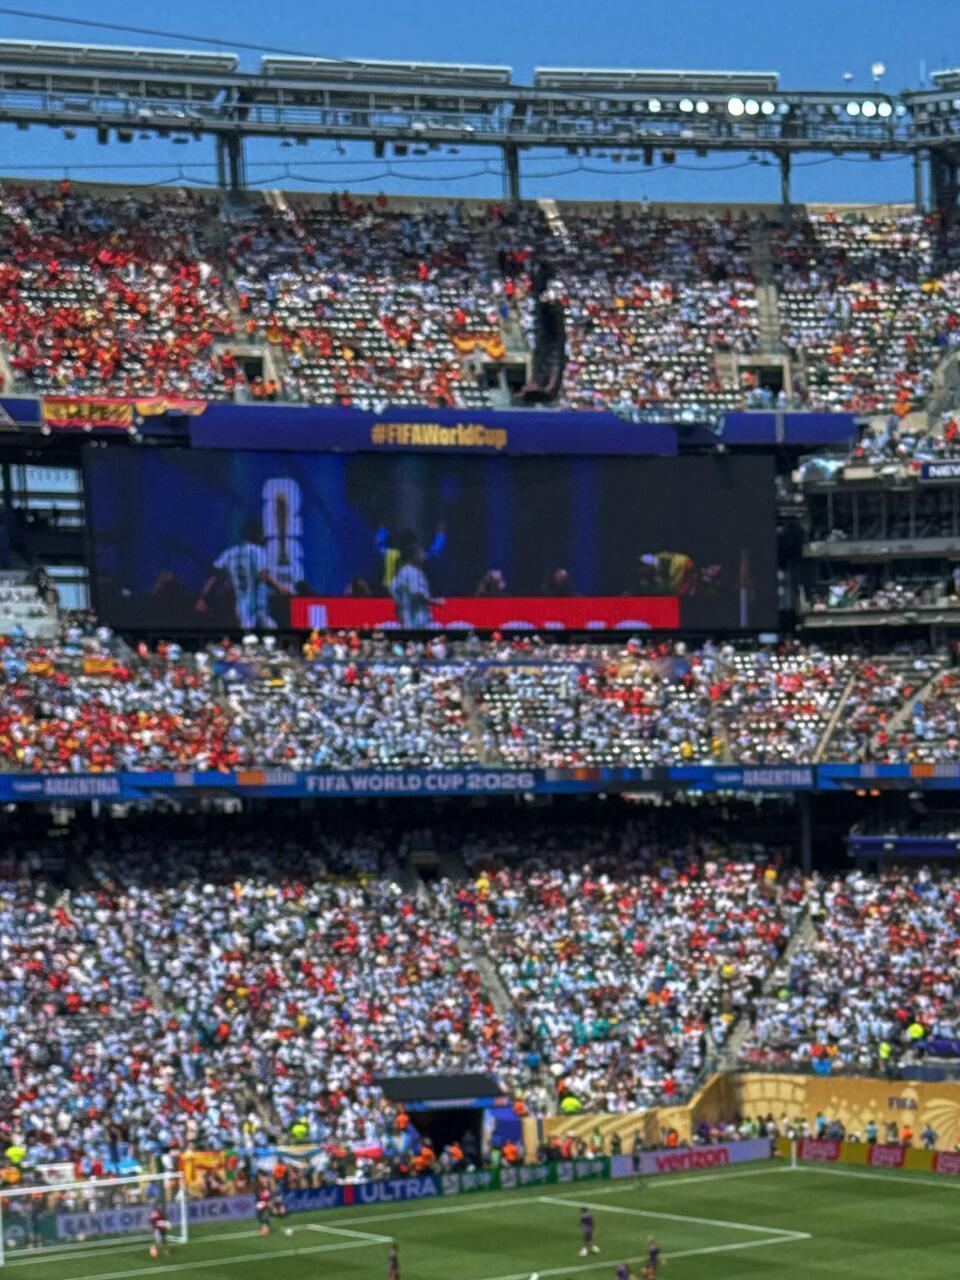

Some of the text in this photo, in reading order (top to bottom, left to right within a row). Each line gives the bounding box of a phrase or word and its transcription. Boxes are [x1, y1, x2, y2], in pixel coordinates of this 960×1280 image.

[371, 423, 507, 449] #FIFAWorldCup
[307, 773, 534, 791] FIFA WORLD CUP 2026
[361, 1178, 437, 1203] ULTRA
[119, 1210, 147, 1228] OF
